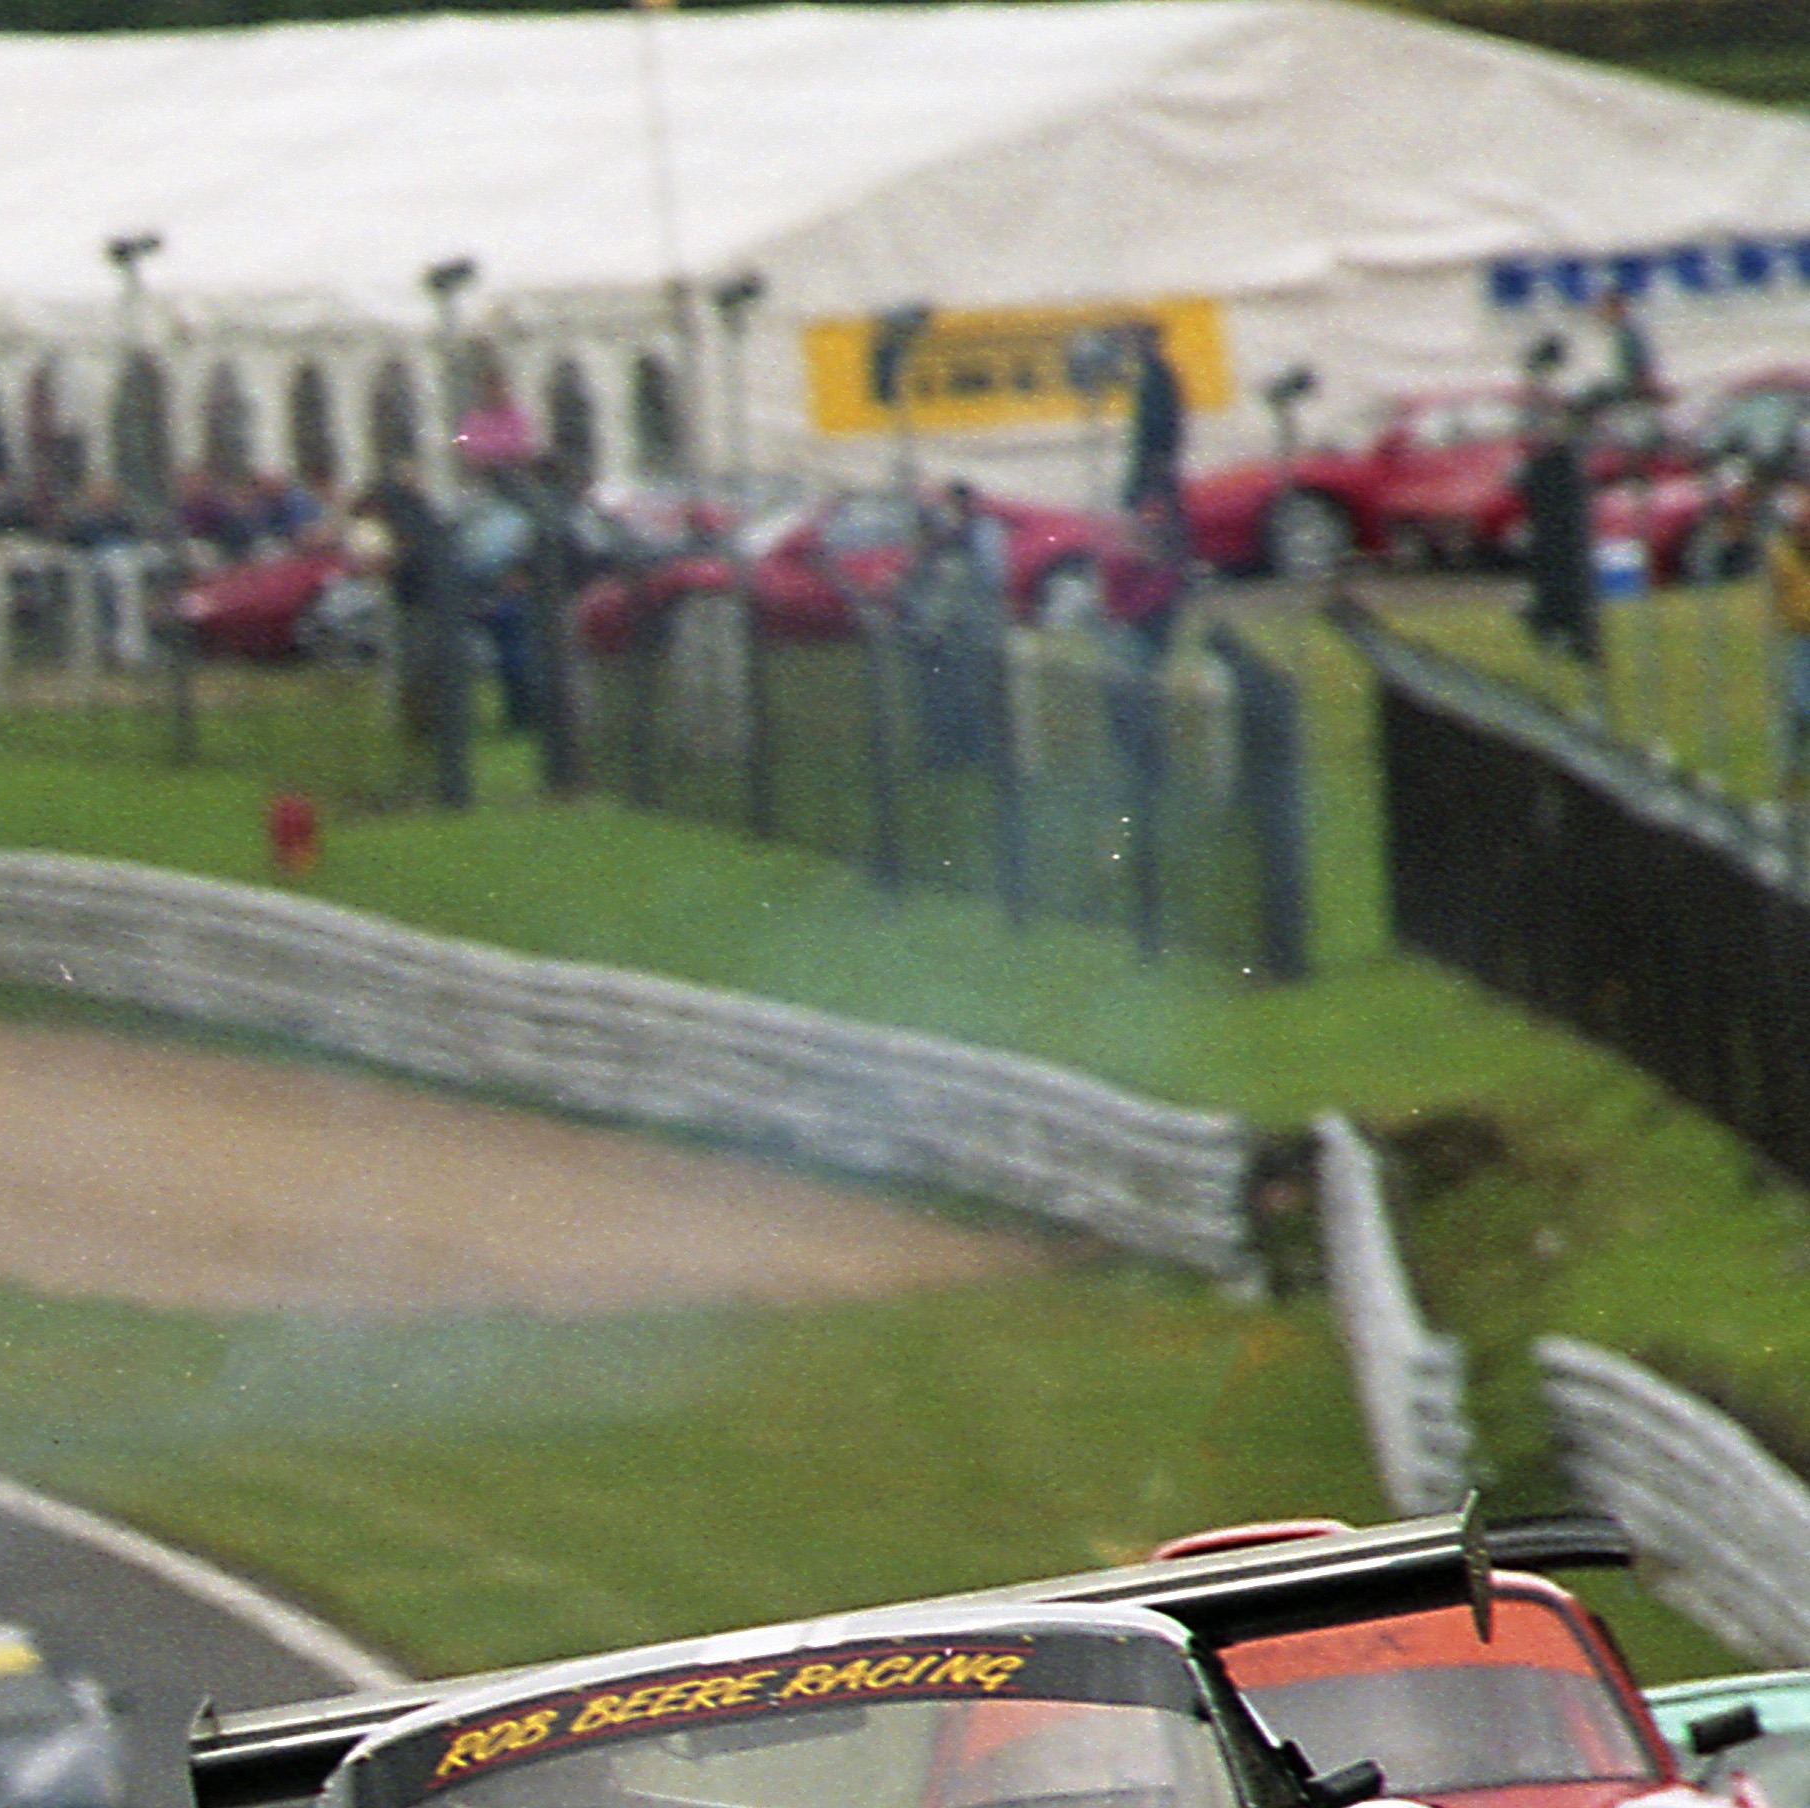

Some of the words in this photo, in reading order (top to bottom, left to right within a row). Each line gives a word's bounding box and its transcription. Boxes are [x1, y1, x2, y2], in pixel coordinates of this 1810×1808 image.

[438, 1708, 557, 1777] ROB
[570, 1669, 778, 1737] BEERE
[782, 1650, 1026, 1698] RACING
